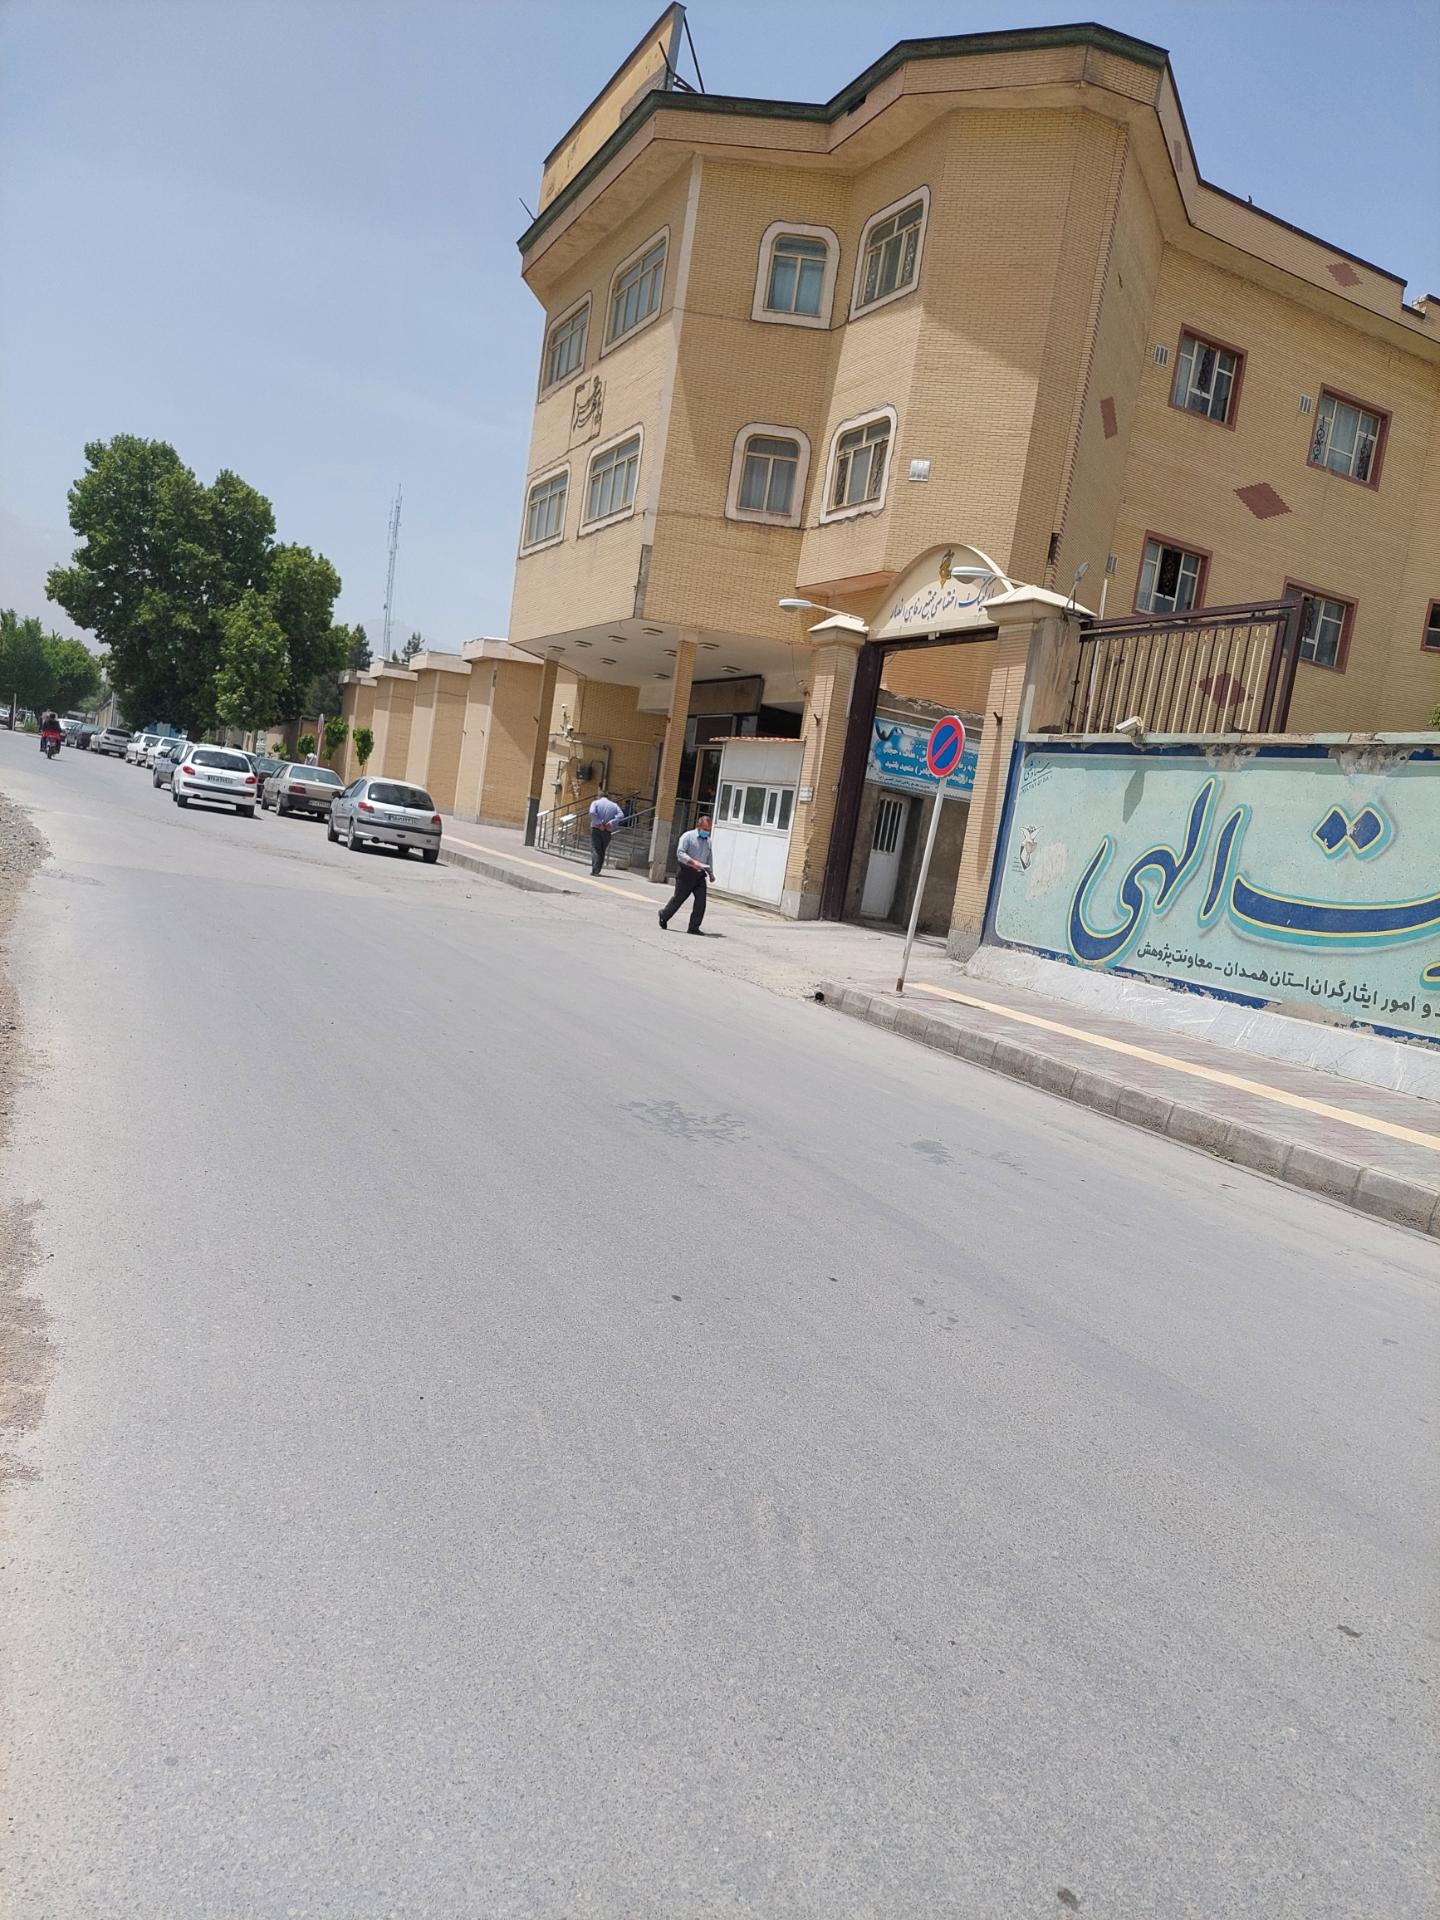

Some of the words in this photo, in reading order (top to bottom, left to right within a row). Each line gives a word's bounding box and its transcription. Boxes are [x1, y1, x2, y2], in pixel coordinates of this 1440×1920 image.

[1067, 774, 1250, 969] الهی
[1136, 941, 1172, 968] پژوهش
[1172, 948, 1213, 969] معاونت
[1223, 962, 1269, 983] همدان
[1270, 971, 1310, 991] استان
[1310, 976, 1378, 1009] ایثارگران
[1381, 996, 1416, 1013] امور
[1421, 1002, 1432, 1019] و
